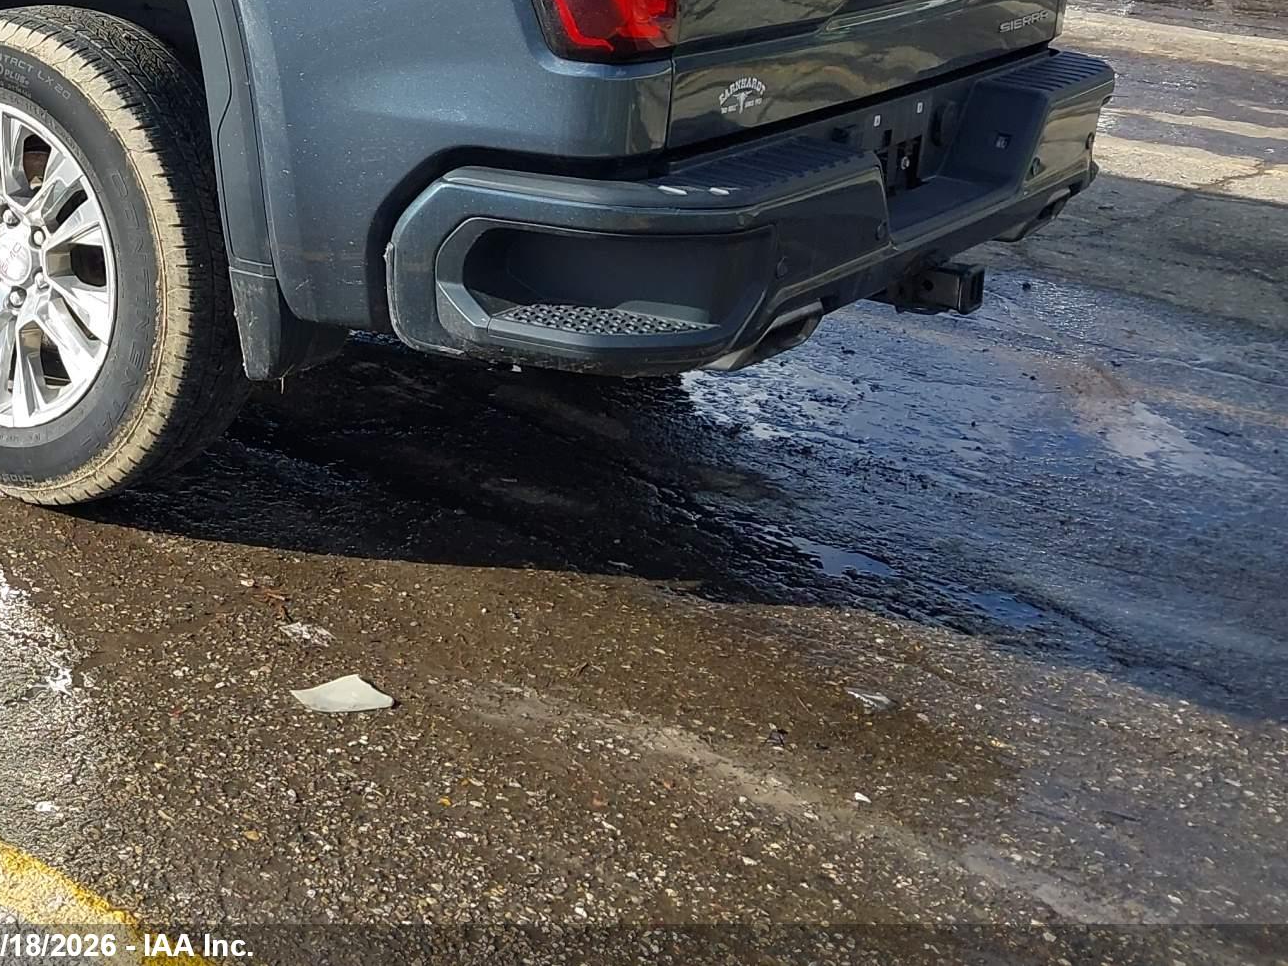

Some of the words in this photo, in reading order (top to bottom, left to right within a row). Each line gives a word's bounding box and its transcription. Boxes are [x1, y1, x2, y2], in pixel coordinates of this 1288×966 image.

[999, 10, 1050, 34] SIERRA
[37, 70, 54, 86] LX
[54, 83, 72, 100] 20
